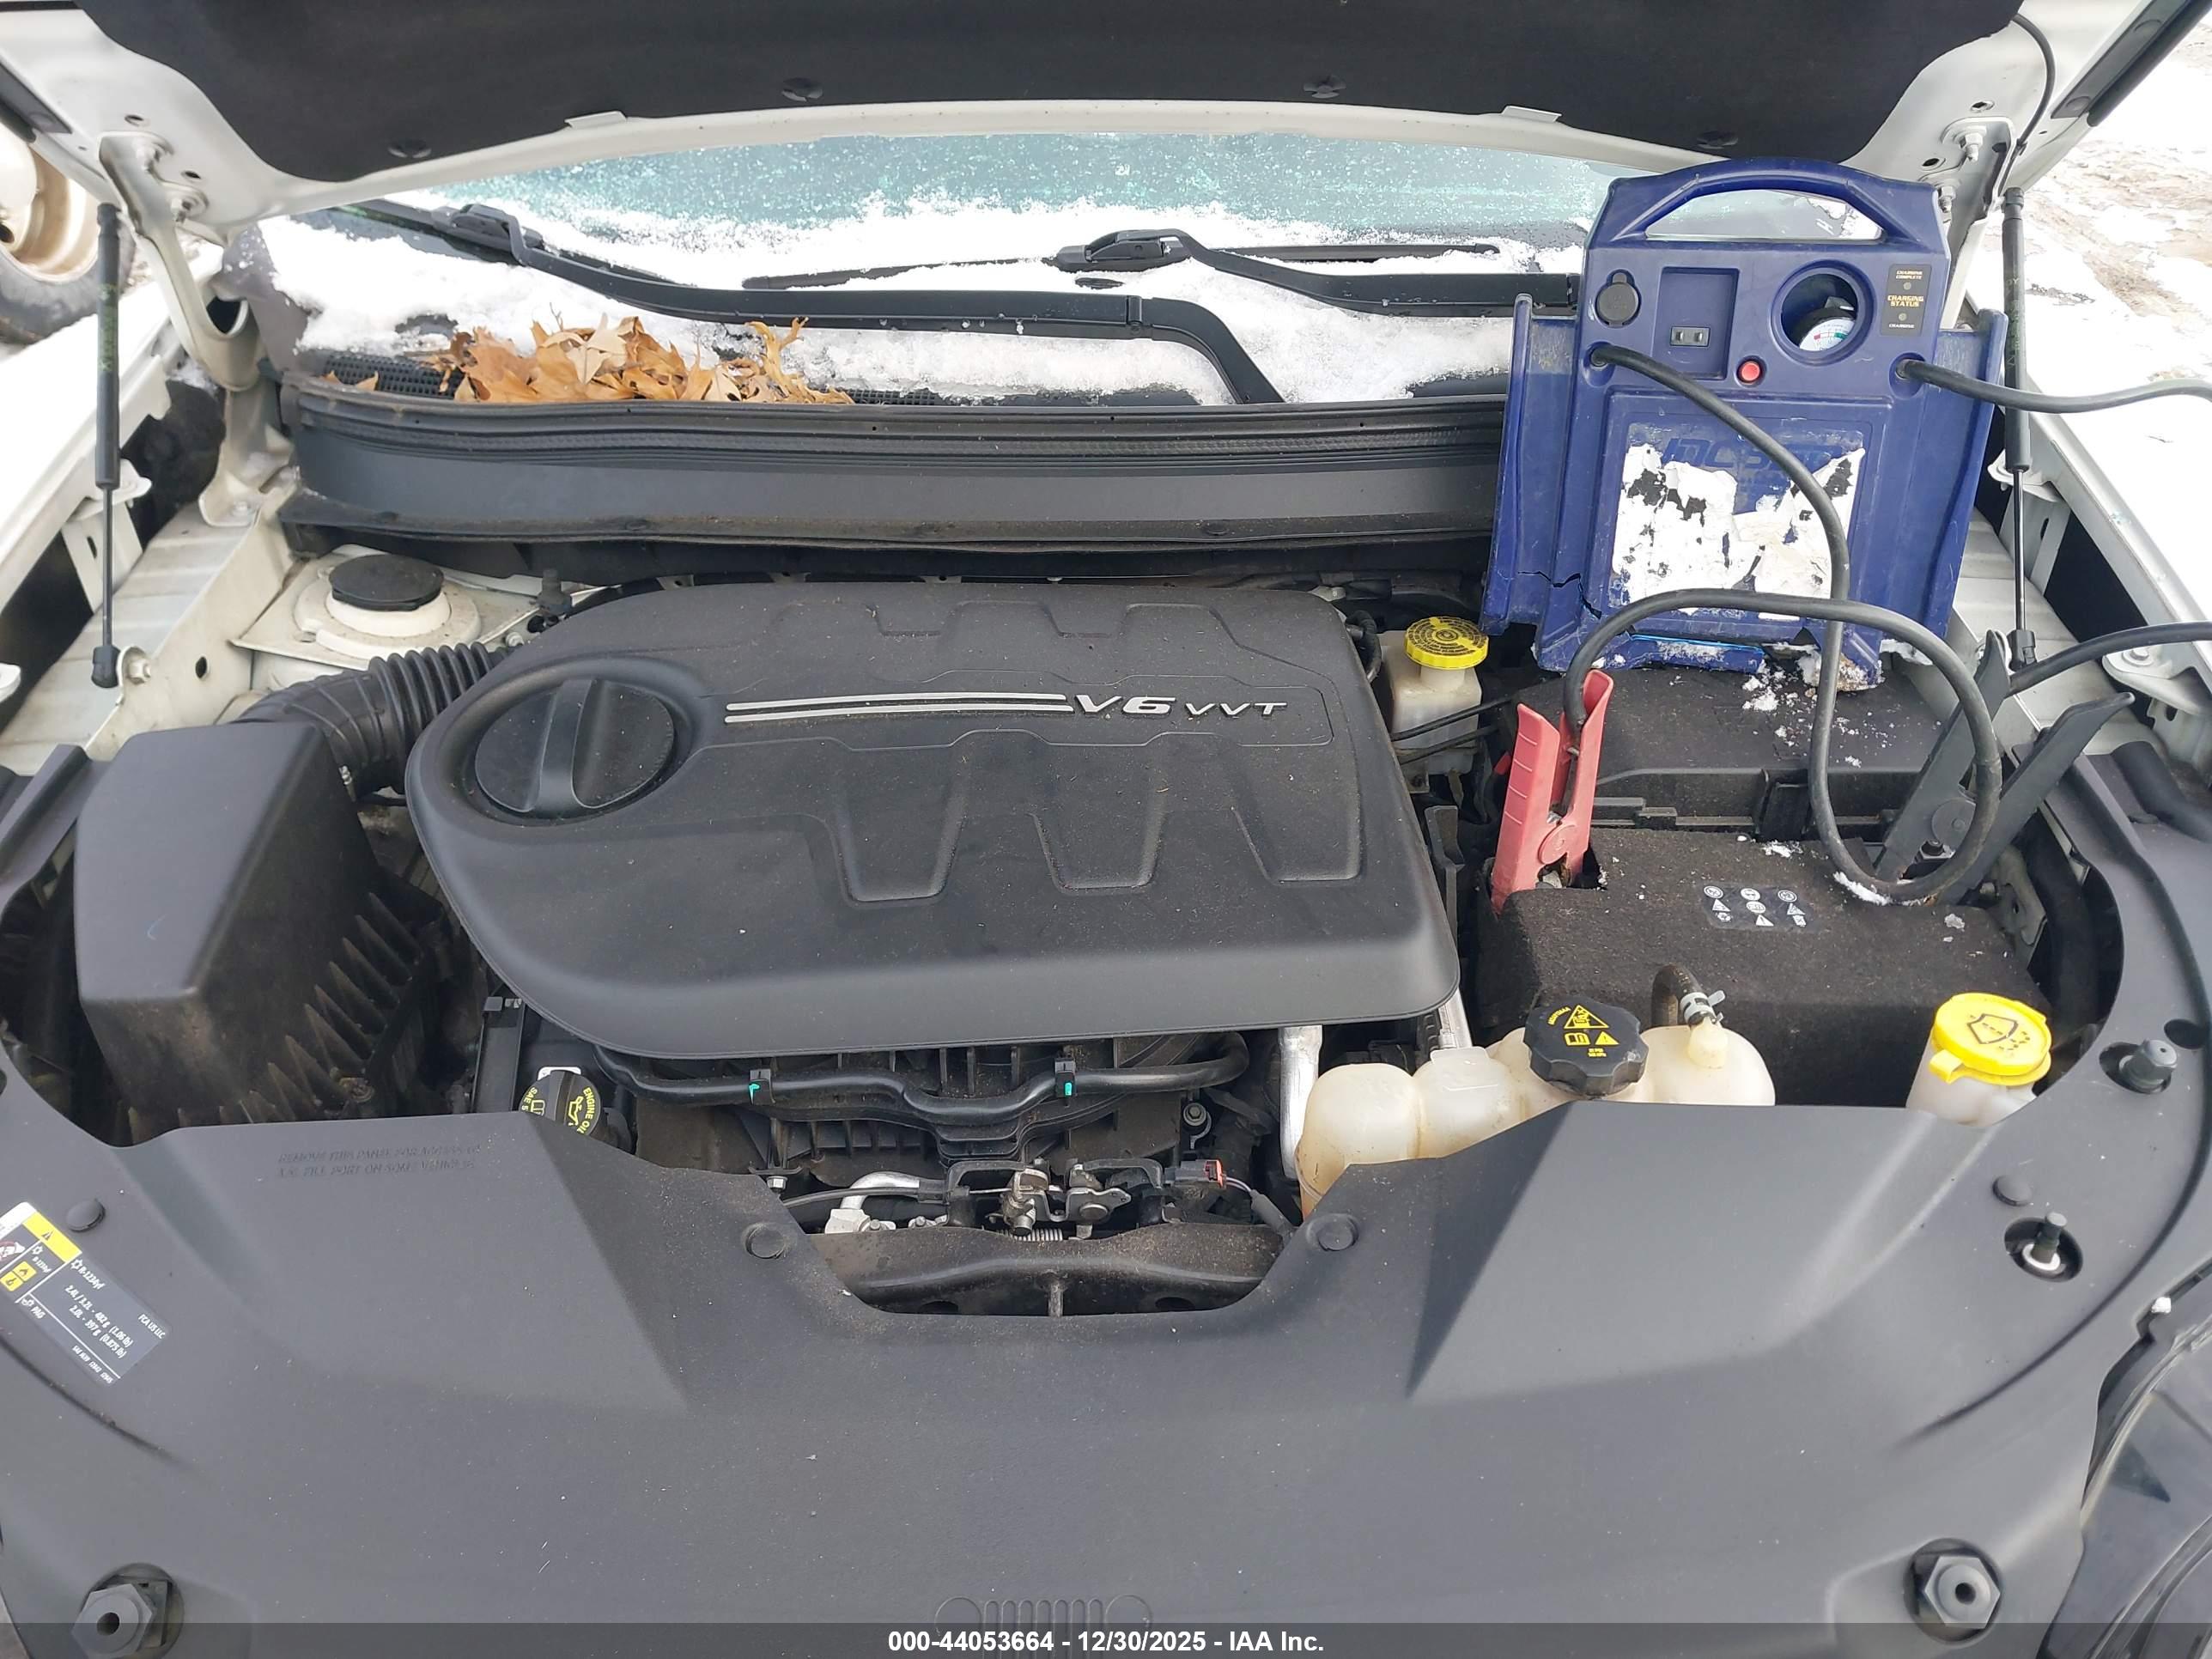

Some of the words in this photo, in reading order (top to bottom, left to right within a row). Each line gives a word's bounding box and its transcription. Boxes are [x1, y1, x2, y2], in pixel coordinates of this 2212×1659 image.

[1075, 694, 1176, 714] V6
[1185, 702, 1288, 716] VVT
[523, 1087, 538, 1104] SAE
[582, 1087, 596, 1120] ENGINE
[576, 1120, 591, 1134] OIL
[137, 1314, 150, 1327] FCA
[148, 1322, 158, 1332] US
[154, 1328, 166, 1340] LLC
